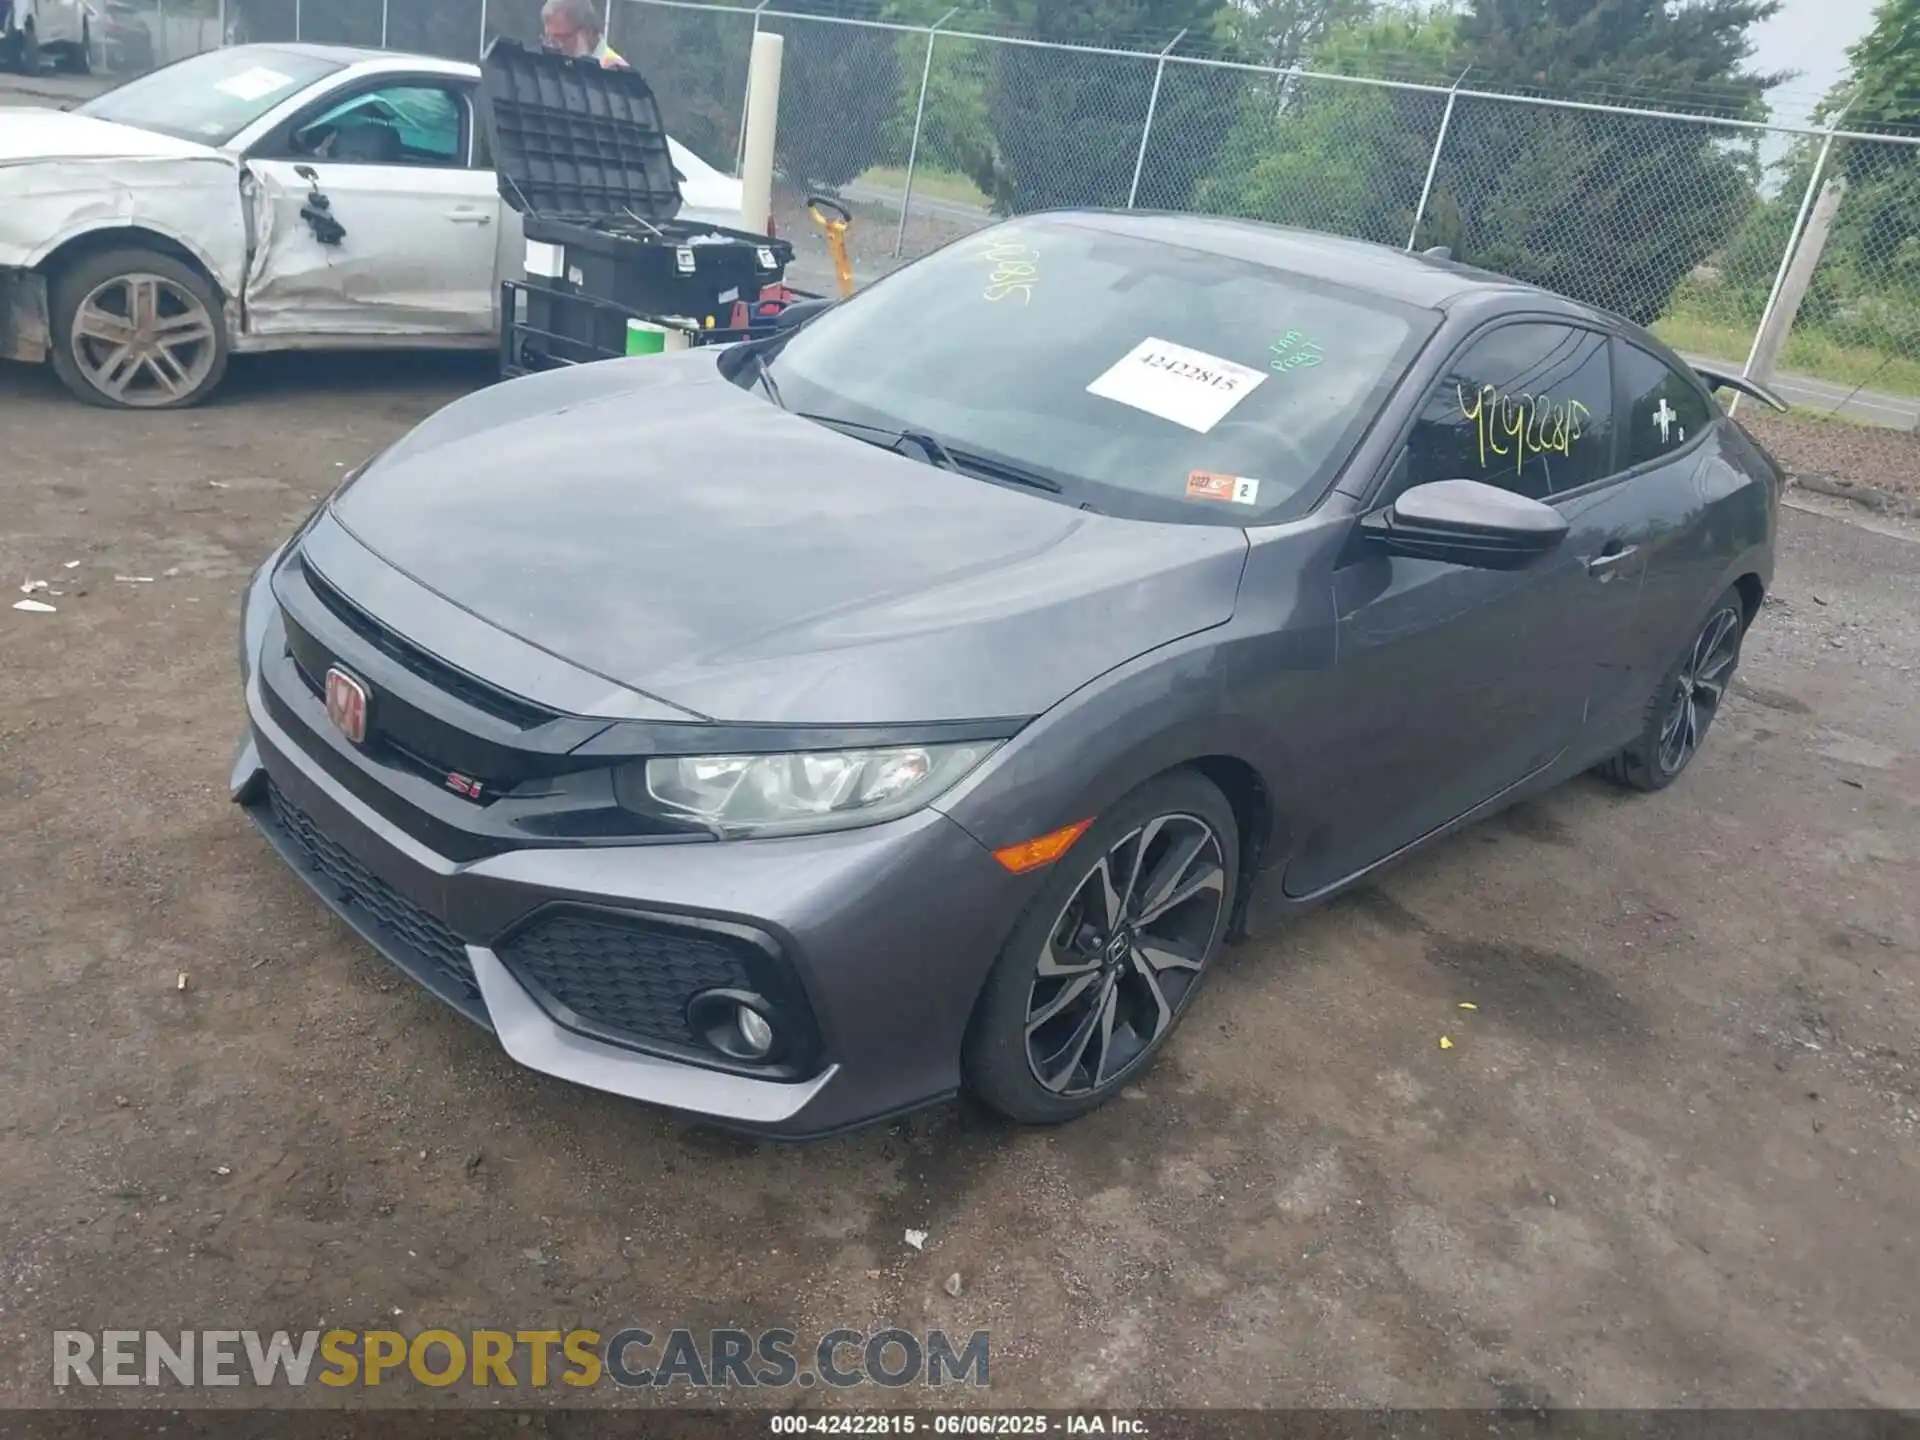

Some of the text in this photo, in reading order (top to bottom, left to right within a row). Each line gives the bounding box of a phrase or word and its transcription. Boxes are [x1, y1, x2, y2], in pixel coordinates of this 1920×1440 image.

[1140, 353, 1239, 391] 42422815
[1456, 383, 1592, 476] 42422815
[1239, 483, 1253, 497] 2
